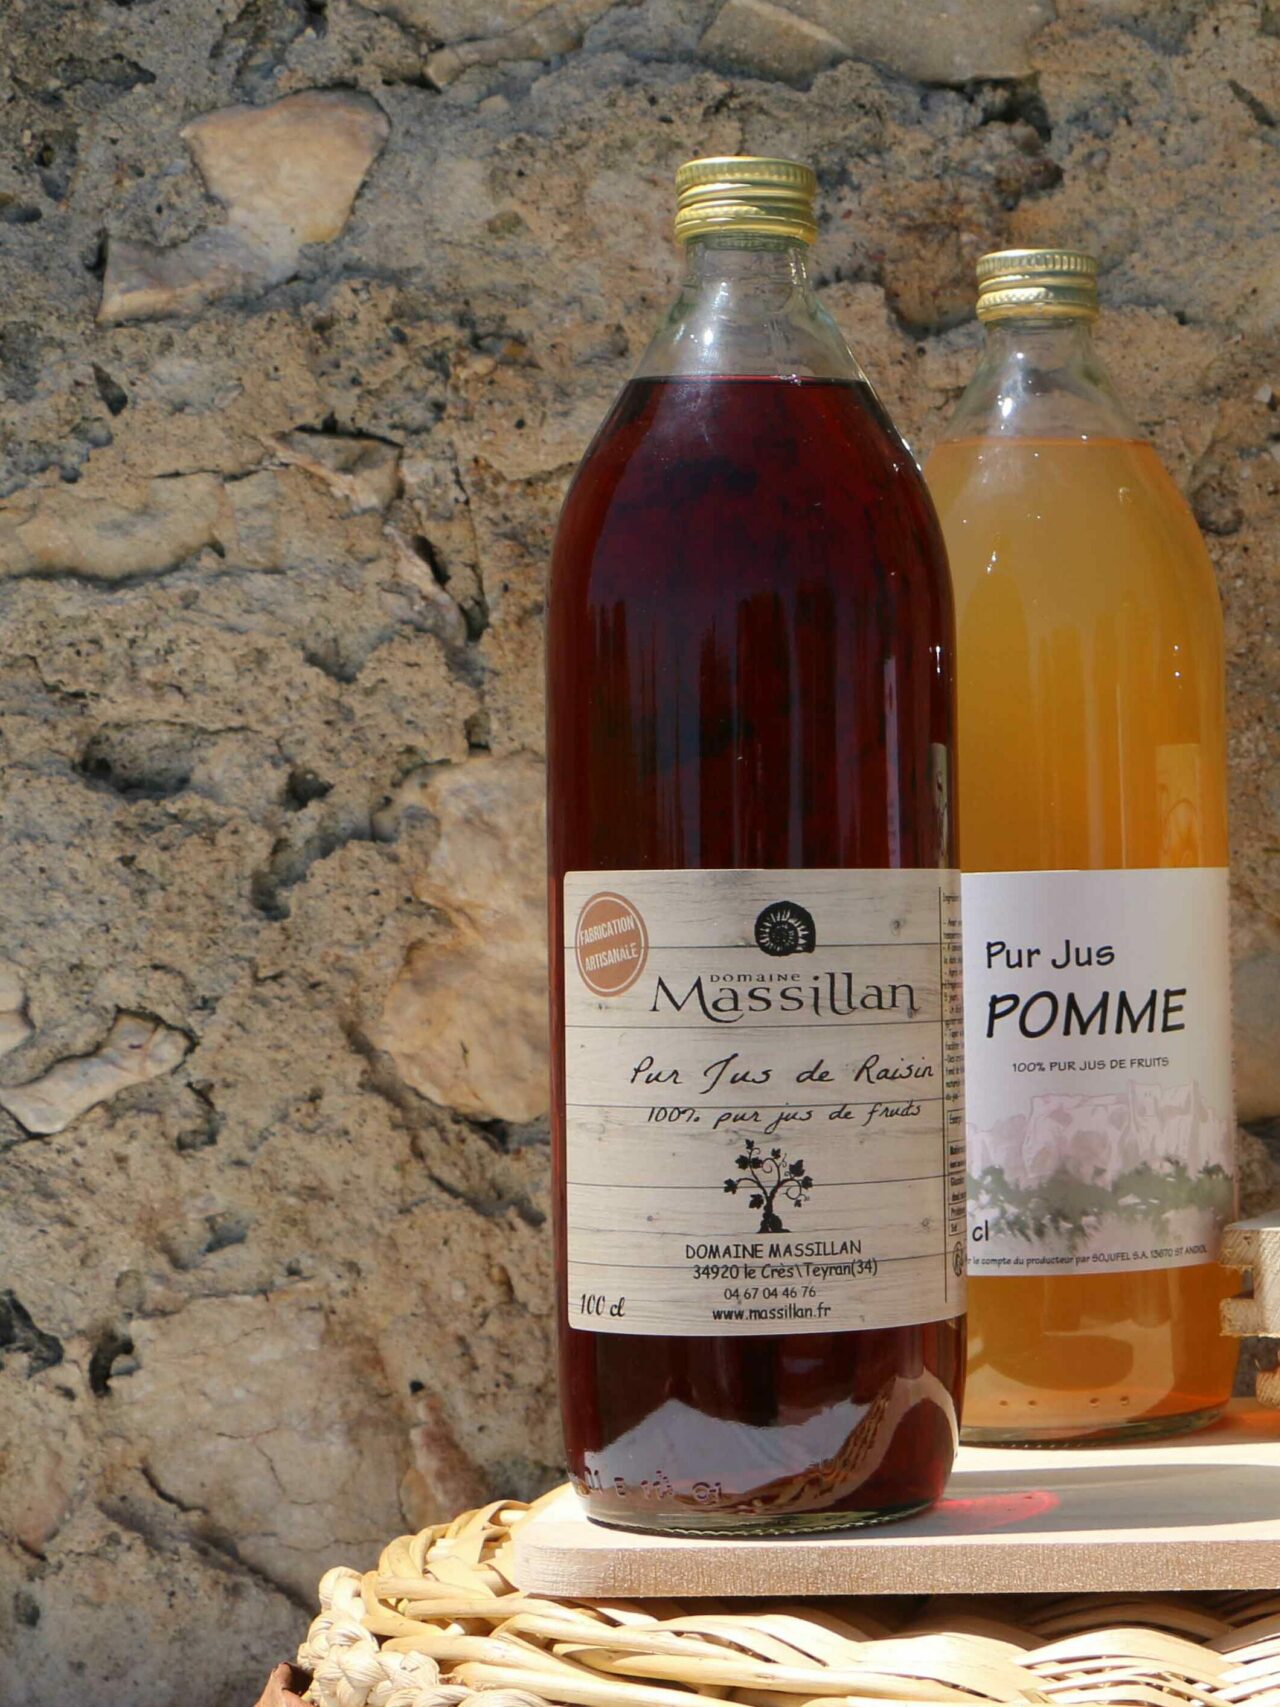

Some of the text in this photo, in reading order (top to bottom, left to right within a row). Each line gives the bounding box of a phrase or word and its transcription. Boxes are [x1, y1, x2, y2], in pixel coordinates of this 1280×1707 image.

[579, 915, 635, 946] FABRICATION
[585, 942, 639, 972] ARTISANALE
[986, 940, 1041, 969] Pur
[1051, 939, 1115, 969] Jus
[649, 972, 921, 1023] Massillan
[986, 988, 1187, 1038] POMME
[630, 1056, 682, 1084] Pur
[700, 1053, 773, 1094] Jus
[796, 1059, 835, 1083] de
[854, 1054, 934, 1084] Raisin
[1012, 1056, 1169, 1073] 100% PUR JUS DE FRUITS
[648, 1100, 921, 1134] 100% pur jus de fruits
[972, 1219, 990, 1242] cl
[685, 1240, 861, 1260] DOMAINE MASSILLAN
[981, 1257, 1011, 1268] compte
[1013, 1256, 1024, 1265] du
[1026, 1255, 1074, 1268] producteur
[1075, 1255, 1090, 1267] par
[693, 1263, 739, 1279] 34920
[744, 1264, 756, 1279] le
[724, 1285, 816, 1300] 04 67 04 46 76
[580, 1293, 625, 1317] 100 cl
[712, 1302, 831, 1321] www.massillan.fr
